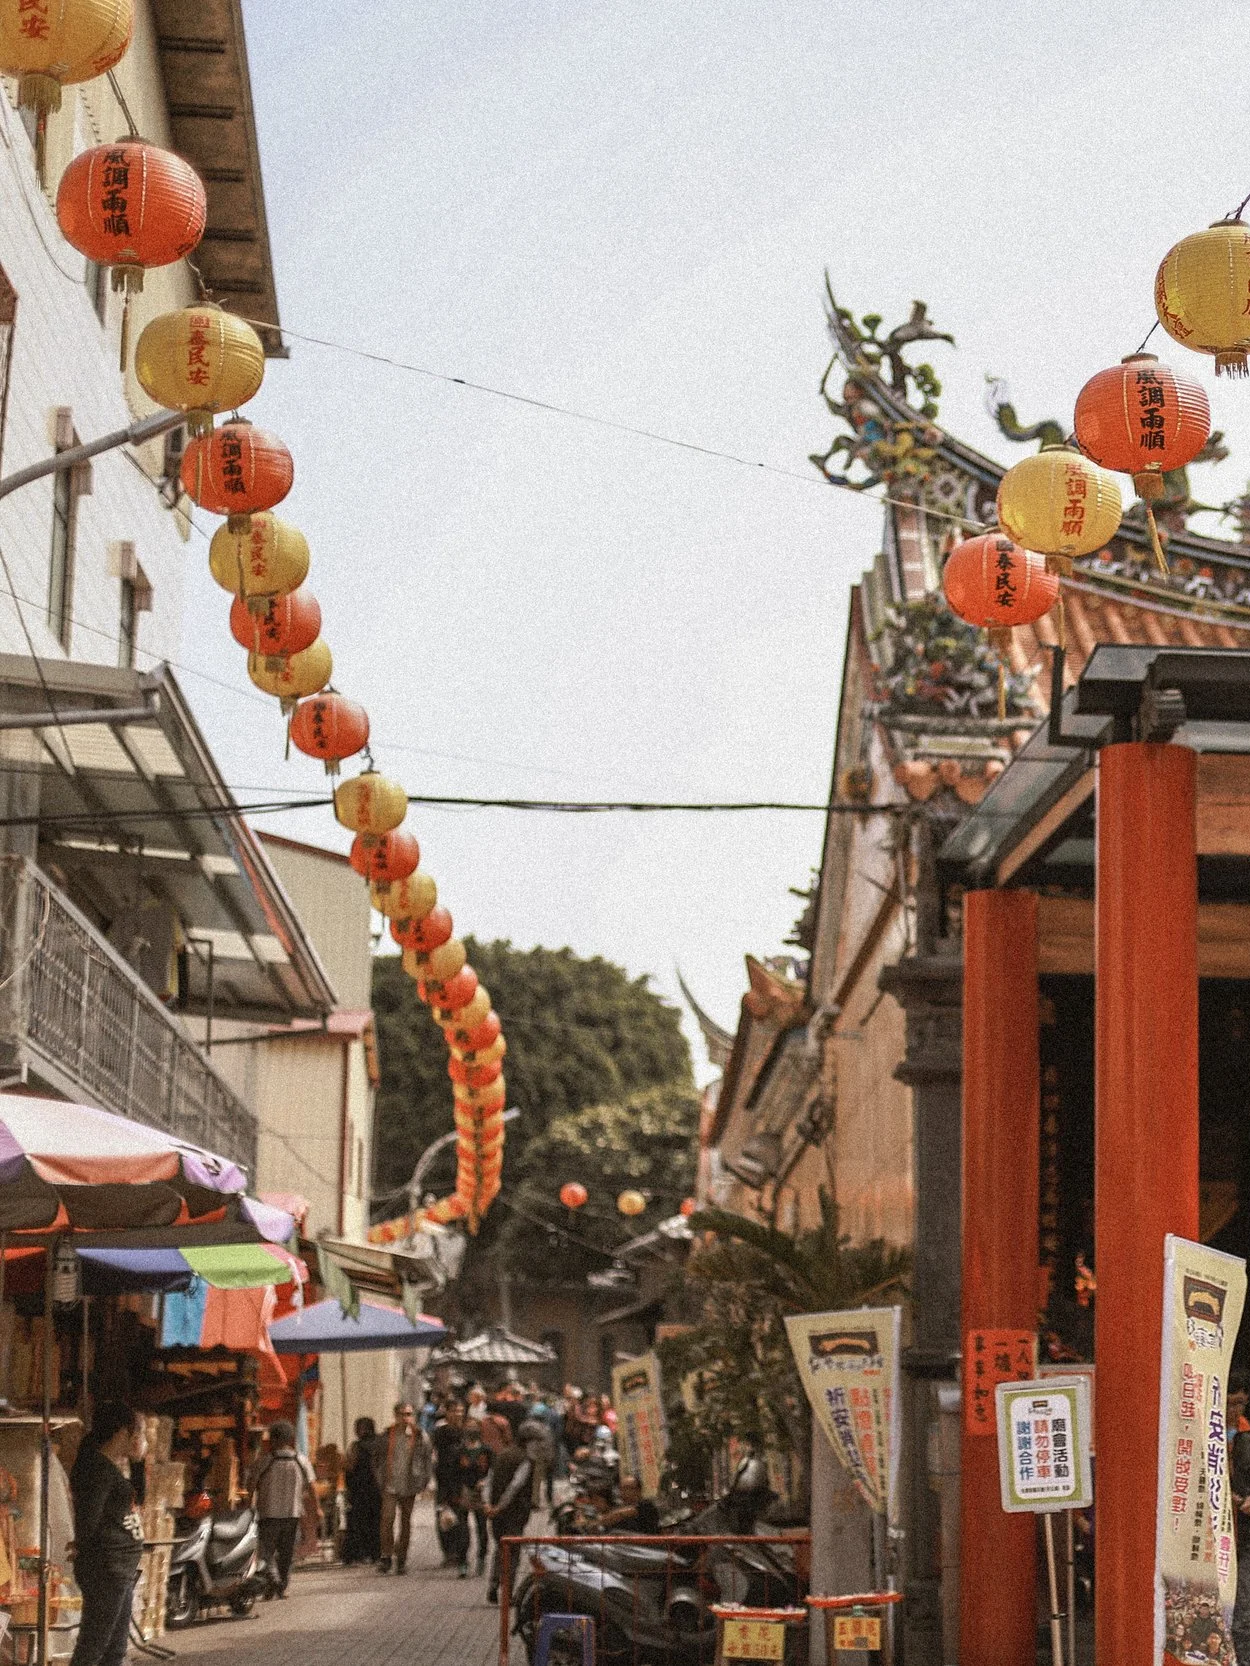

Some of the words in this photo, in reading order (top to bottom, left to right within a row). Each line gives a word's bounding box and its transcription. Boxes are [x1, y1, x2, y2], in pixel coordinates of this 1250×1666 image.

[102, 149, 132, 238] 風調雨順
[186, 314, 211, 387] 國泰民安
[1136, 368, 1167, 452] 風調雨順
[220, 429, 247, 495] 風調雨順
[1059, 462, 1088, 538] 風調雨順
[994, 540, 1017, 608] 國泰民安
[1015, 1420, 1034, 1481] 謝謝合作
[1033, 1418, 1052, 1479] 請勿停車
[1051, 1417, 1070, 1479] 廟會活動
